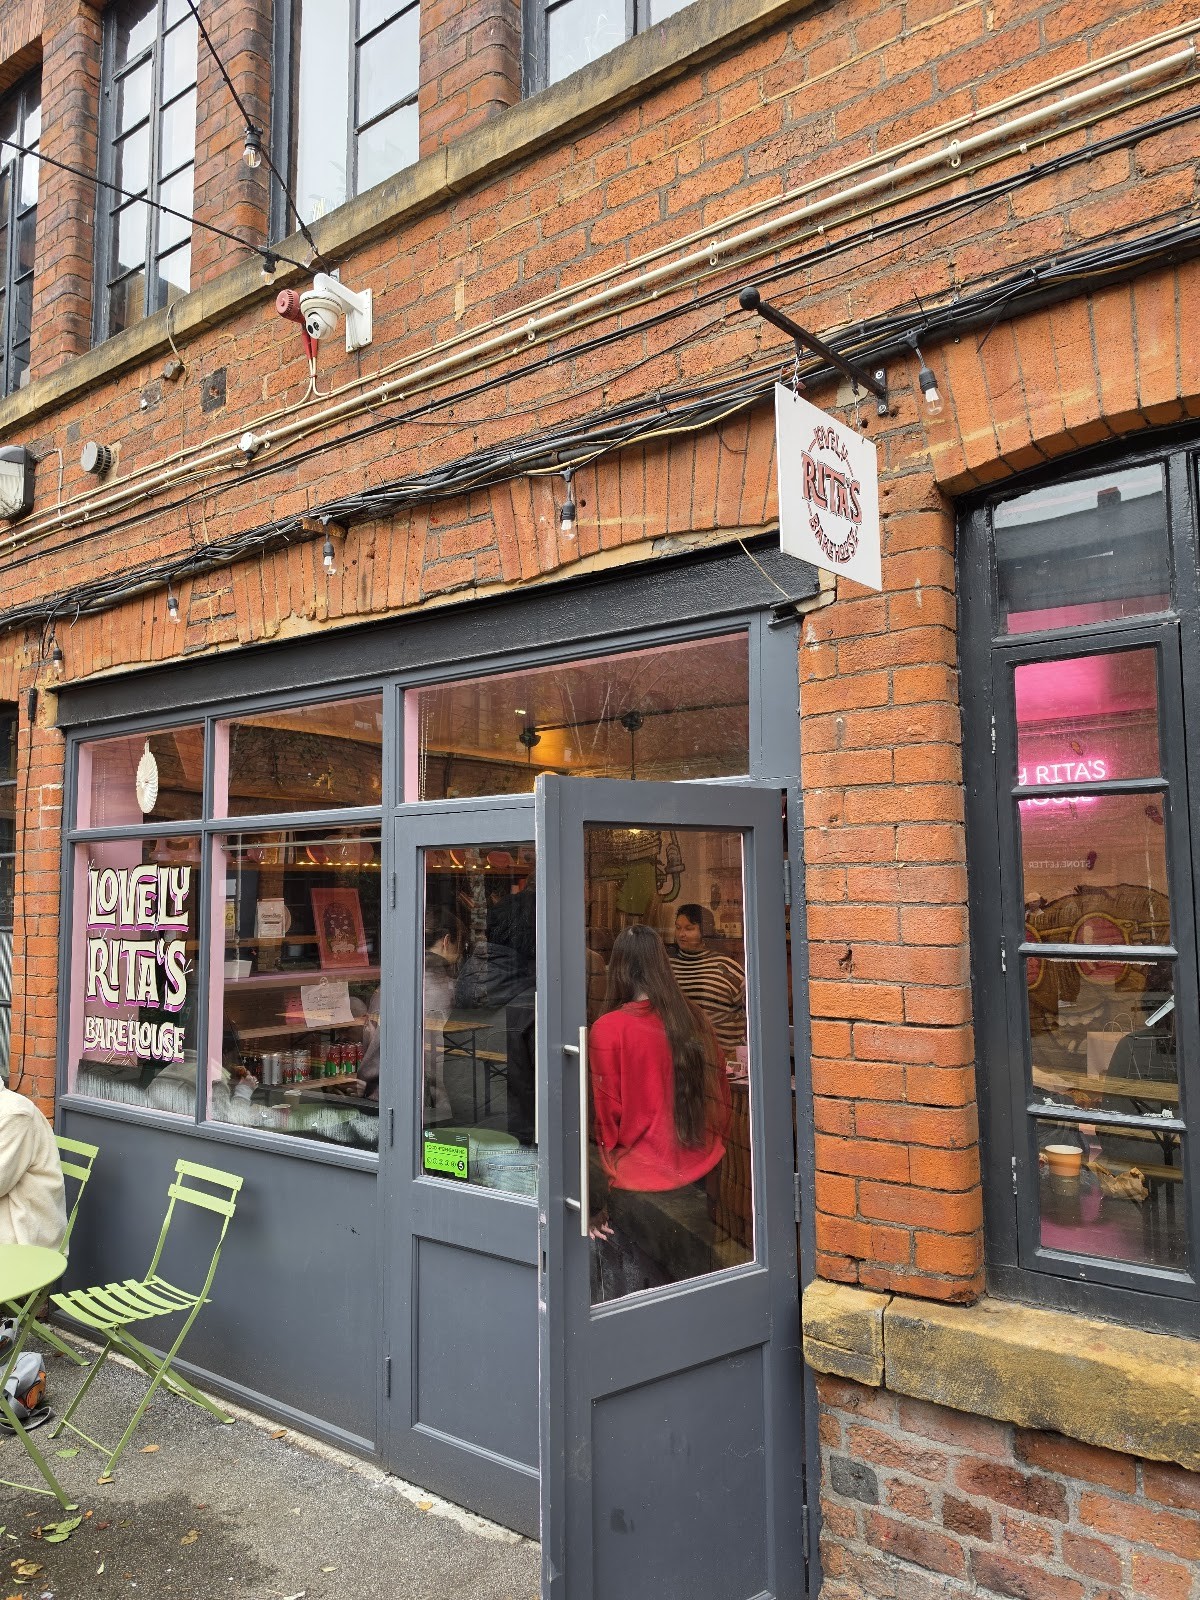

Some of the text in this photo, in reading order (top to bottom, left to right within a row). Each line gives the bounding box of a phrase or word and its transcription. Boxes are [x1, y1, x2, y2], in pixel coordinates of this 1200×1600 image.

[801, 449, 863, 526] RITA'S
[808, 512, 860, 564] BAKEHOUSE
[1036, 759, 1106, 784] RITA'S
[87, 863, 191, 931] LOVELY
[85, 937, 187, 1013] RITA'S
[84, 1016, 186, 1063] BAKEHOUSE
[458, 1161, 464, 1170] 5
